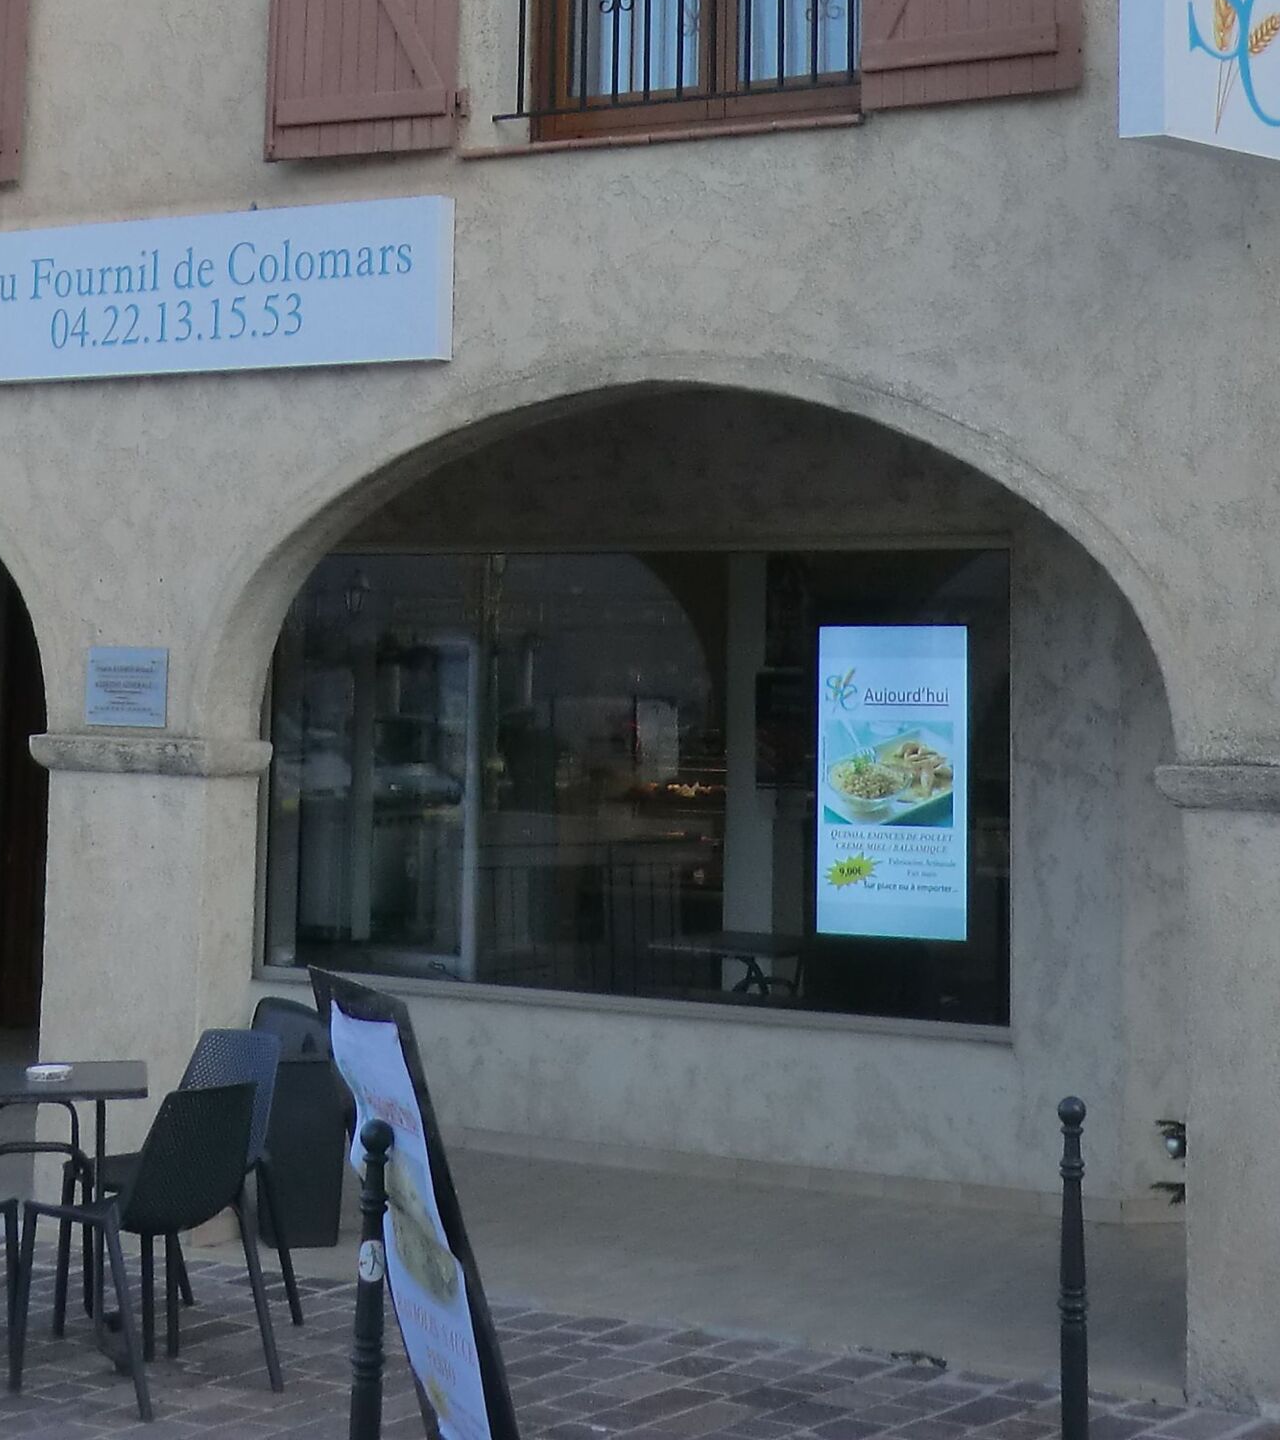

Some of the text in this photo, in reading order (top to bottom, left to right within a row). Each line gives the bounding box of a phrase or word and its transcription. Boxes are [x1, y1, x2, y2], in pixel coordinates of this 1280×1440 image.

[30, 250, 160, 301] Fournil
[173, 248, 215, 290] de
[227, 239, 414, 288] Colomars
[49, 292, 304, 351] 04.22.13.15.53
[863, 687, 949, 705] Aujourd'hui
[863, 880, 876, 889] Sur
[876, 882, 898, 891] place
